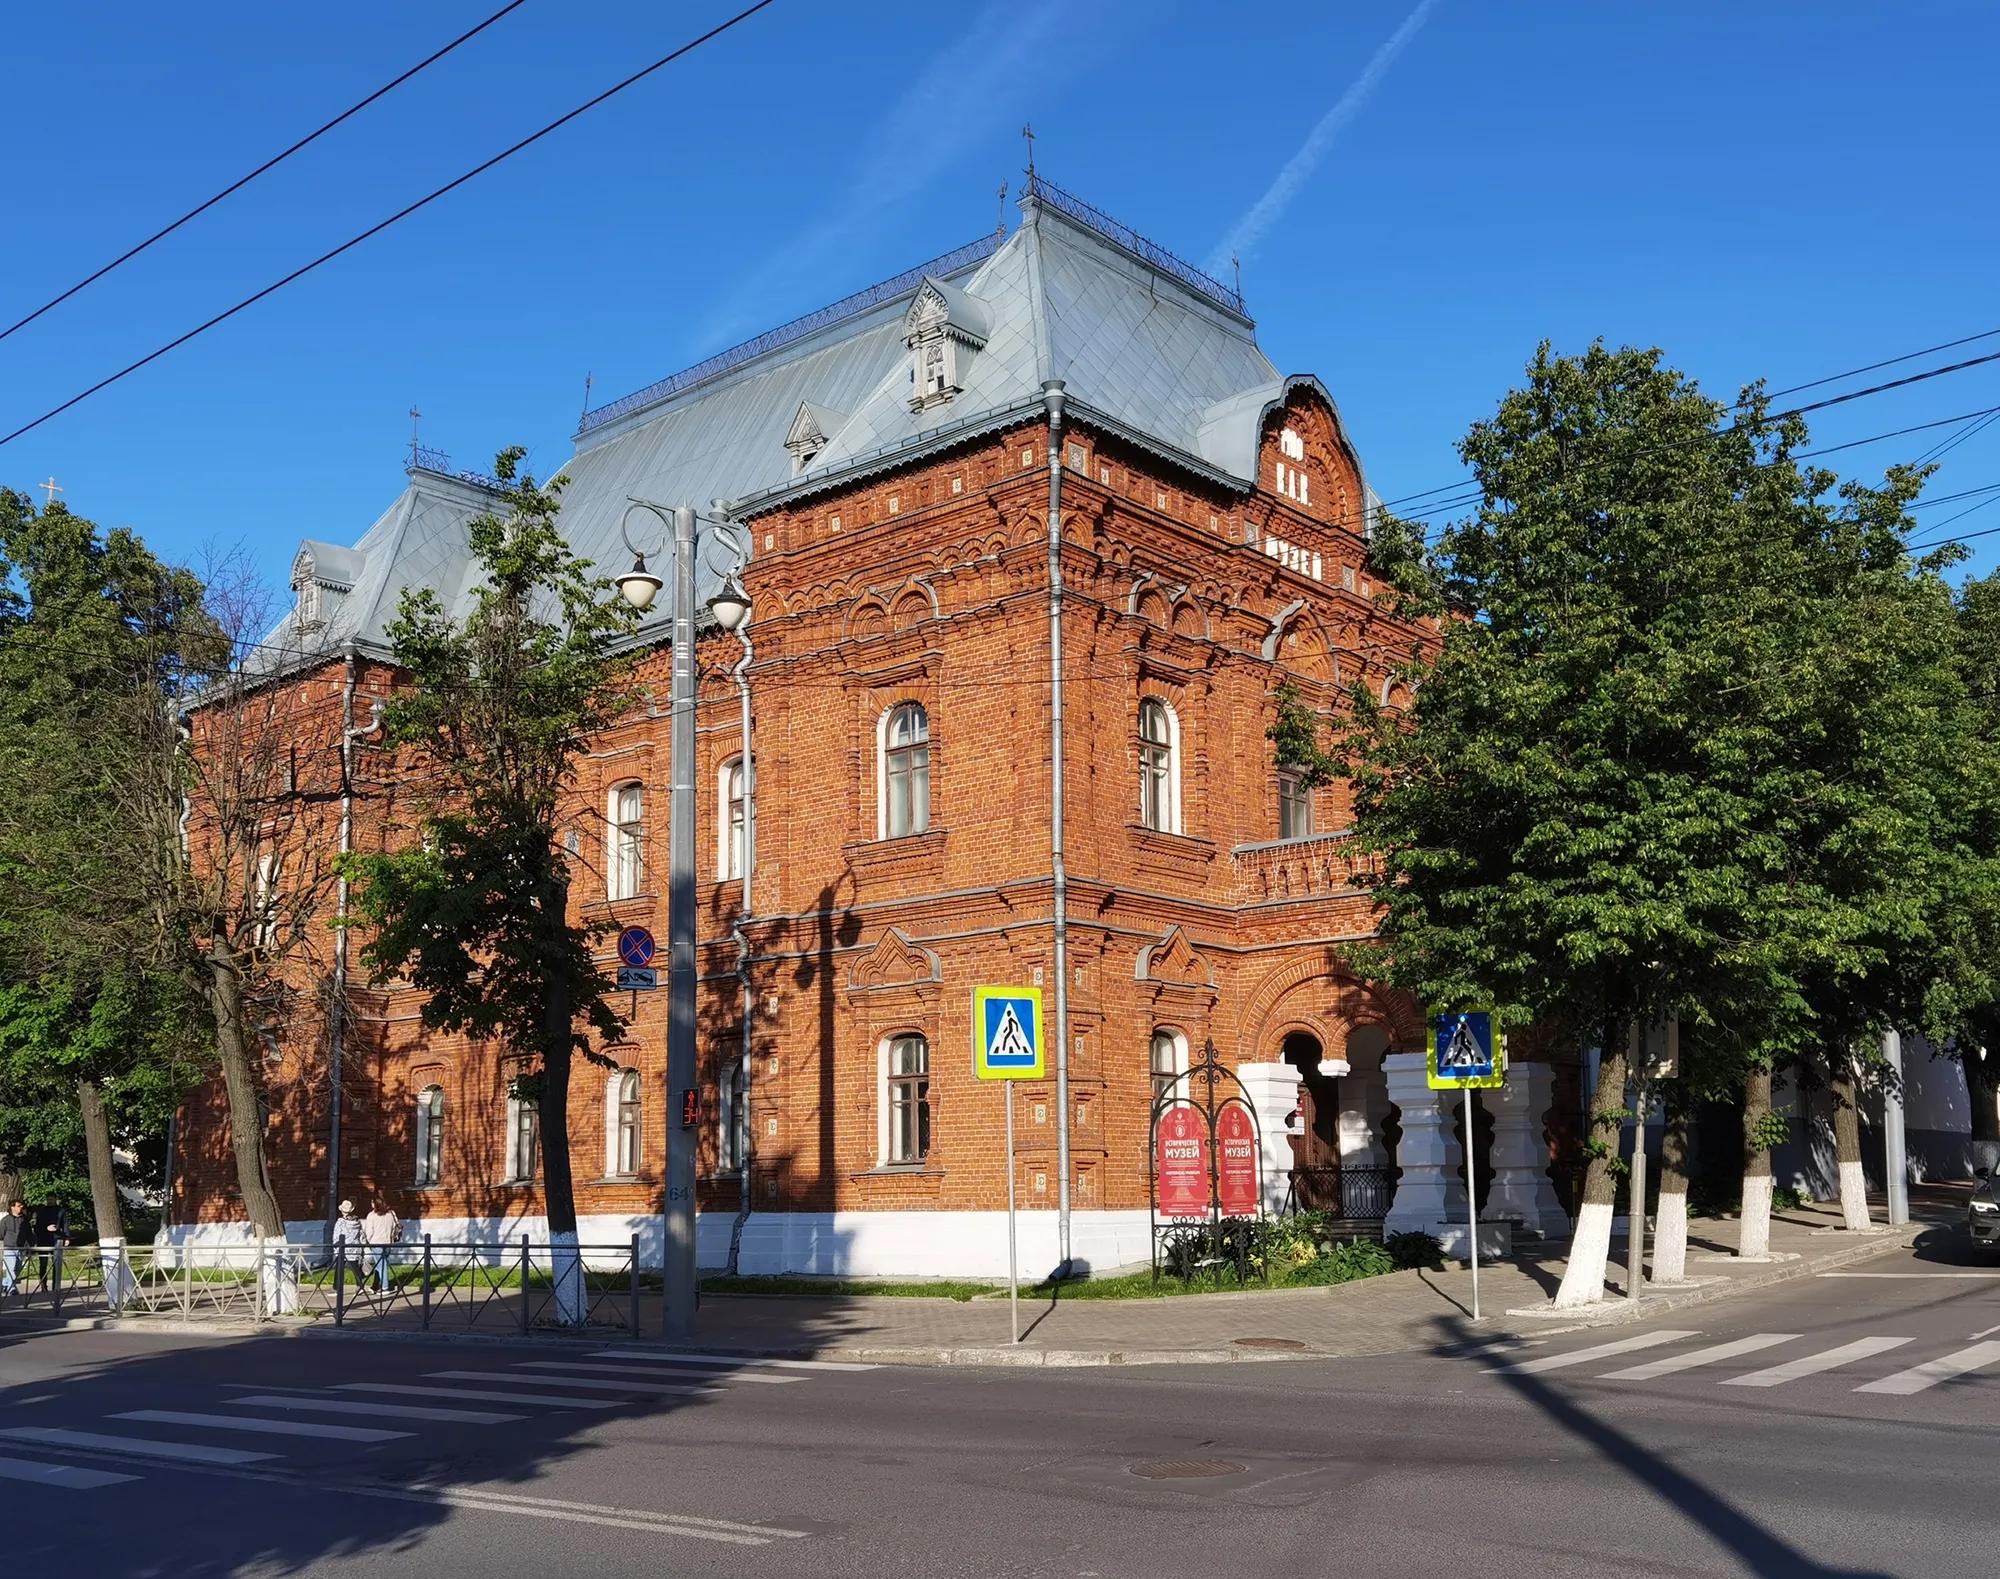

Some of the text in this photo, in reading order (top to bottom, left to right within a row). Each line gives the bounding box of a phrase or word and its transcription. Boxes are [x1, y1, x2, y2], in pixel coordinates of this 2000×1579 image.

[1265, 535, 1322, 581] МУЗЕЙ
[1165, 1146, 1200, 1158] МУЗЕЙ
[1225, 1146, 1251, 1158] МУЗЕЙ
